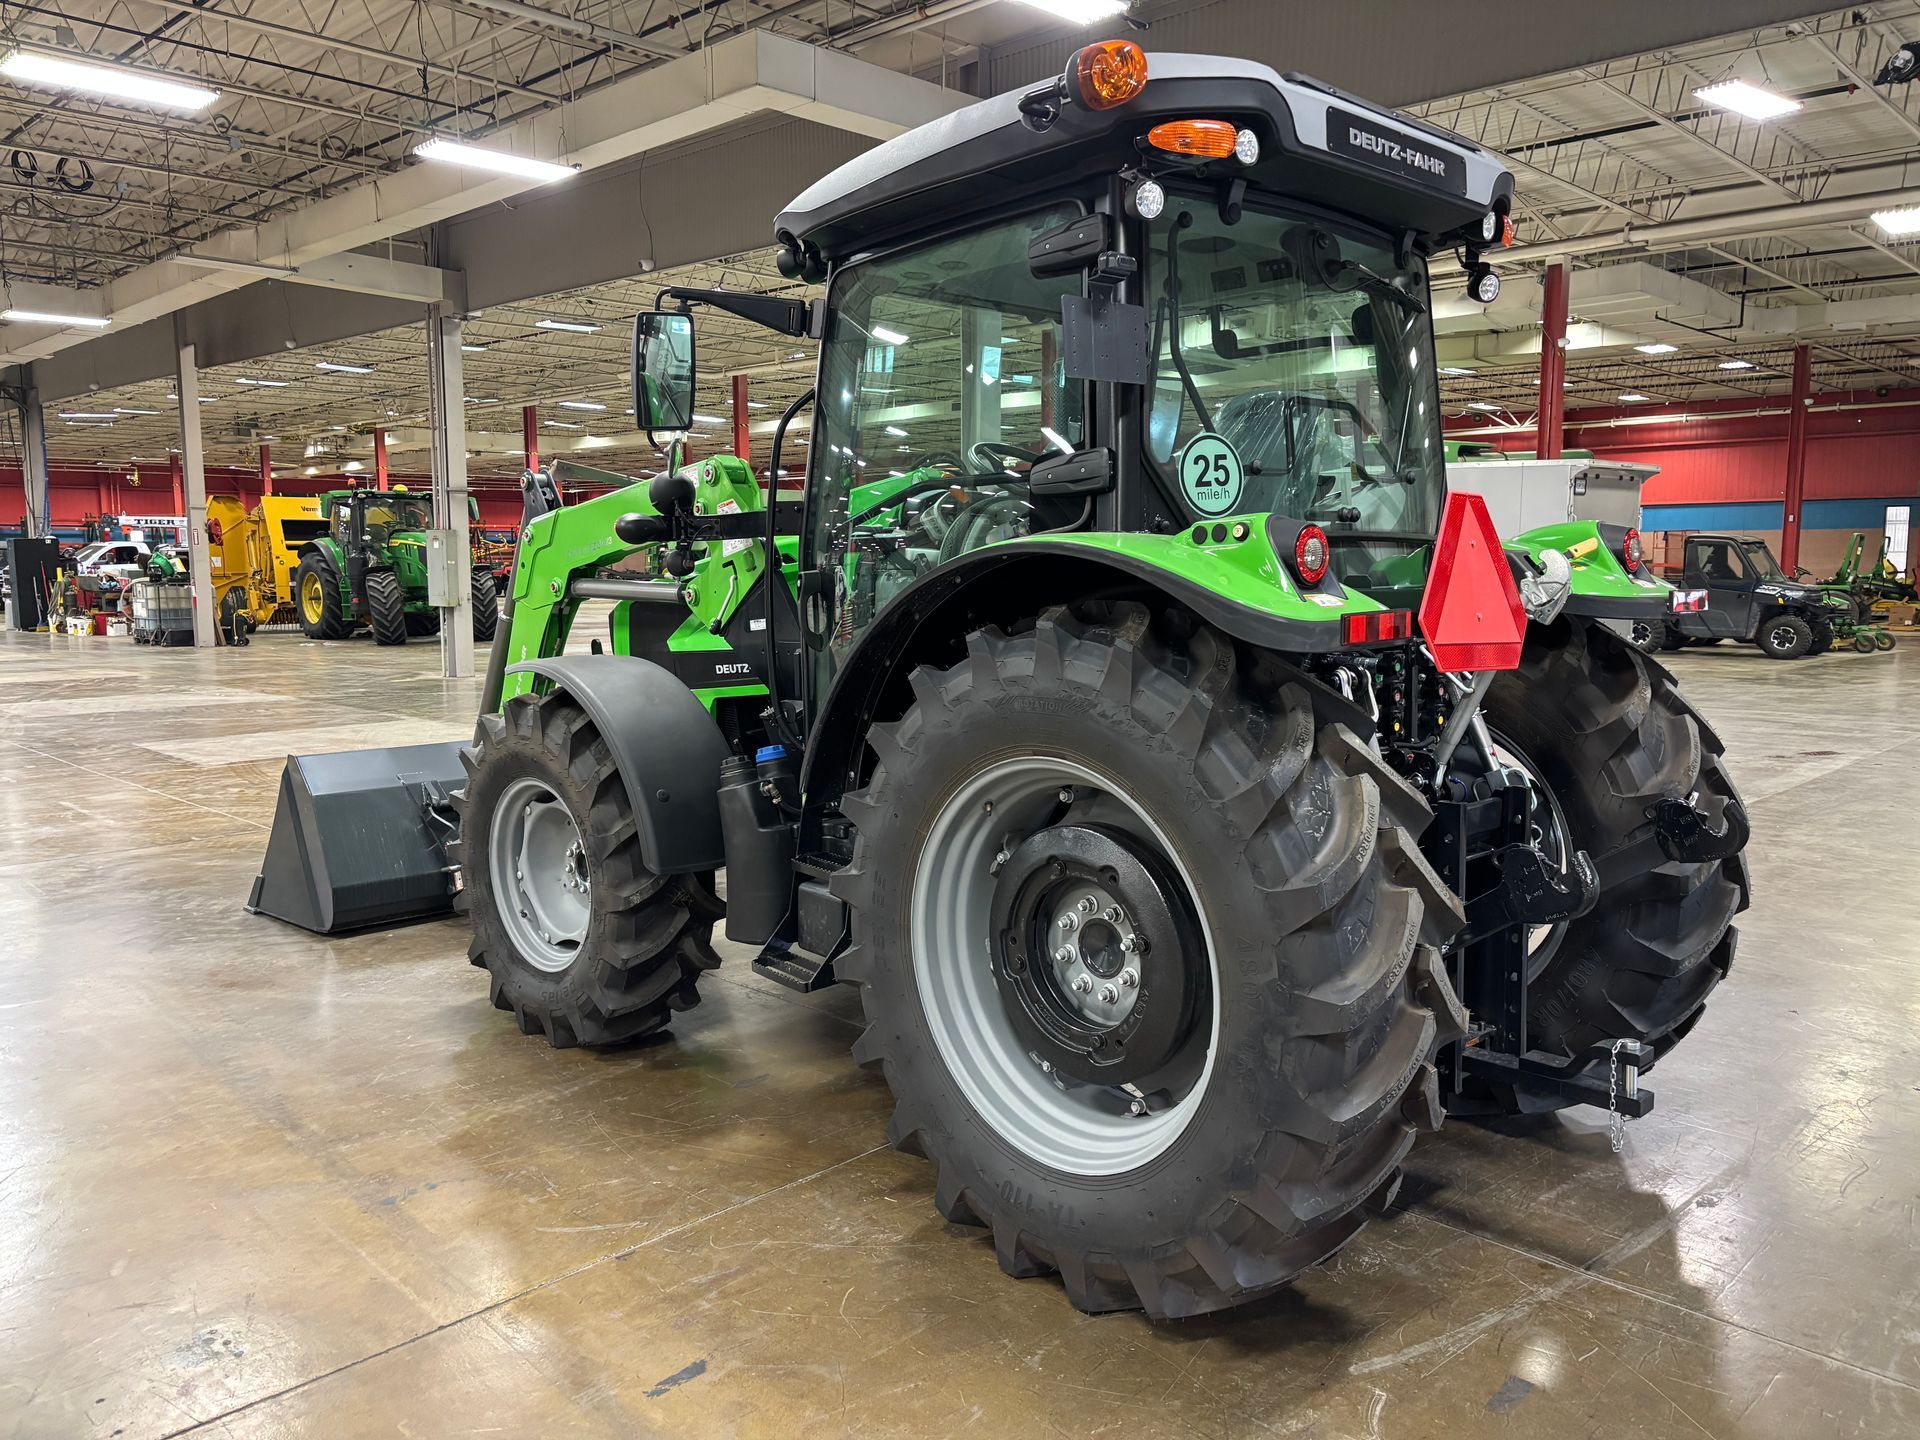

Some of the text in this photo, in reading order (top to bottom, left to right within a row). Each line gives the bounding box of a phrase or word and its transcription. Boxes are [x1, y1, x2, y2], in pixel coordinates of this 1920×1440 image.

[1349, 127, 1446, 177] DEUTZ-FAHR
[1193, 453, 1230, 488] 25
[1197, 488, 1231, 501] mile/h
